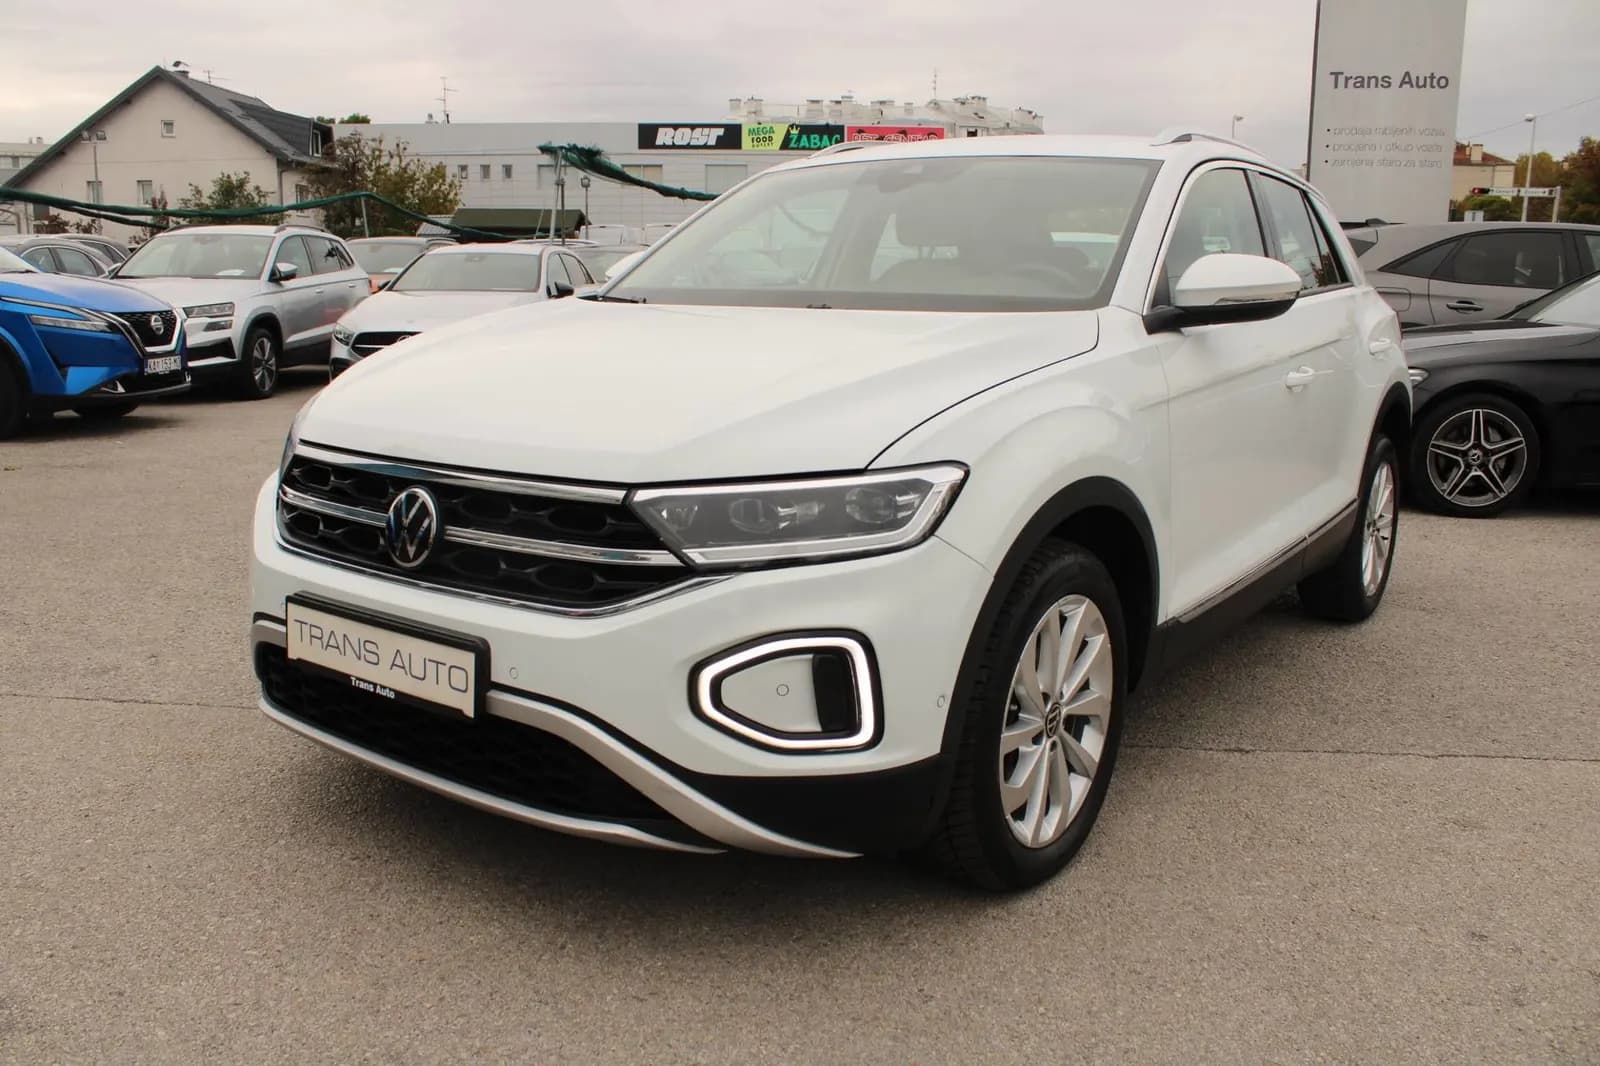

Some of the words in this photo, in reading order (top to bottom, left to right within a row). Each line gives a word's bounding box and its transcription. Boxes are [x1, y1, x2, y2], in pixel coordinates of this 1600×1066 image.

[1329, 71, 1392, 89] Trans
[1398, 71, 1450, 89] Auto
[655, 127, 725, 146] ROST
[748, 126, 775, 136] MEGA
[751, 136, 774, 144] FOOD
[294, 619, 380, 666] TRANS
[390, 649, 469, 694] AUTO
[350, 676, 374, 693] Trans
[375, 685, 395, 699] Auto
